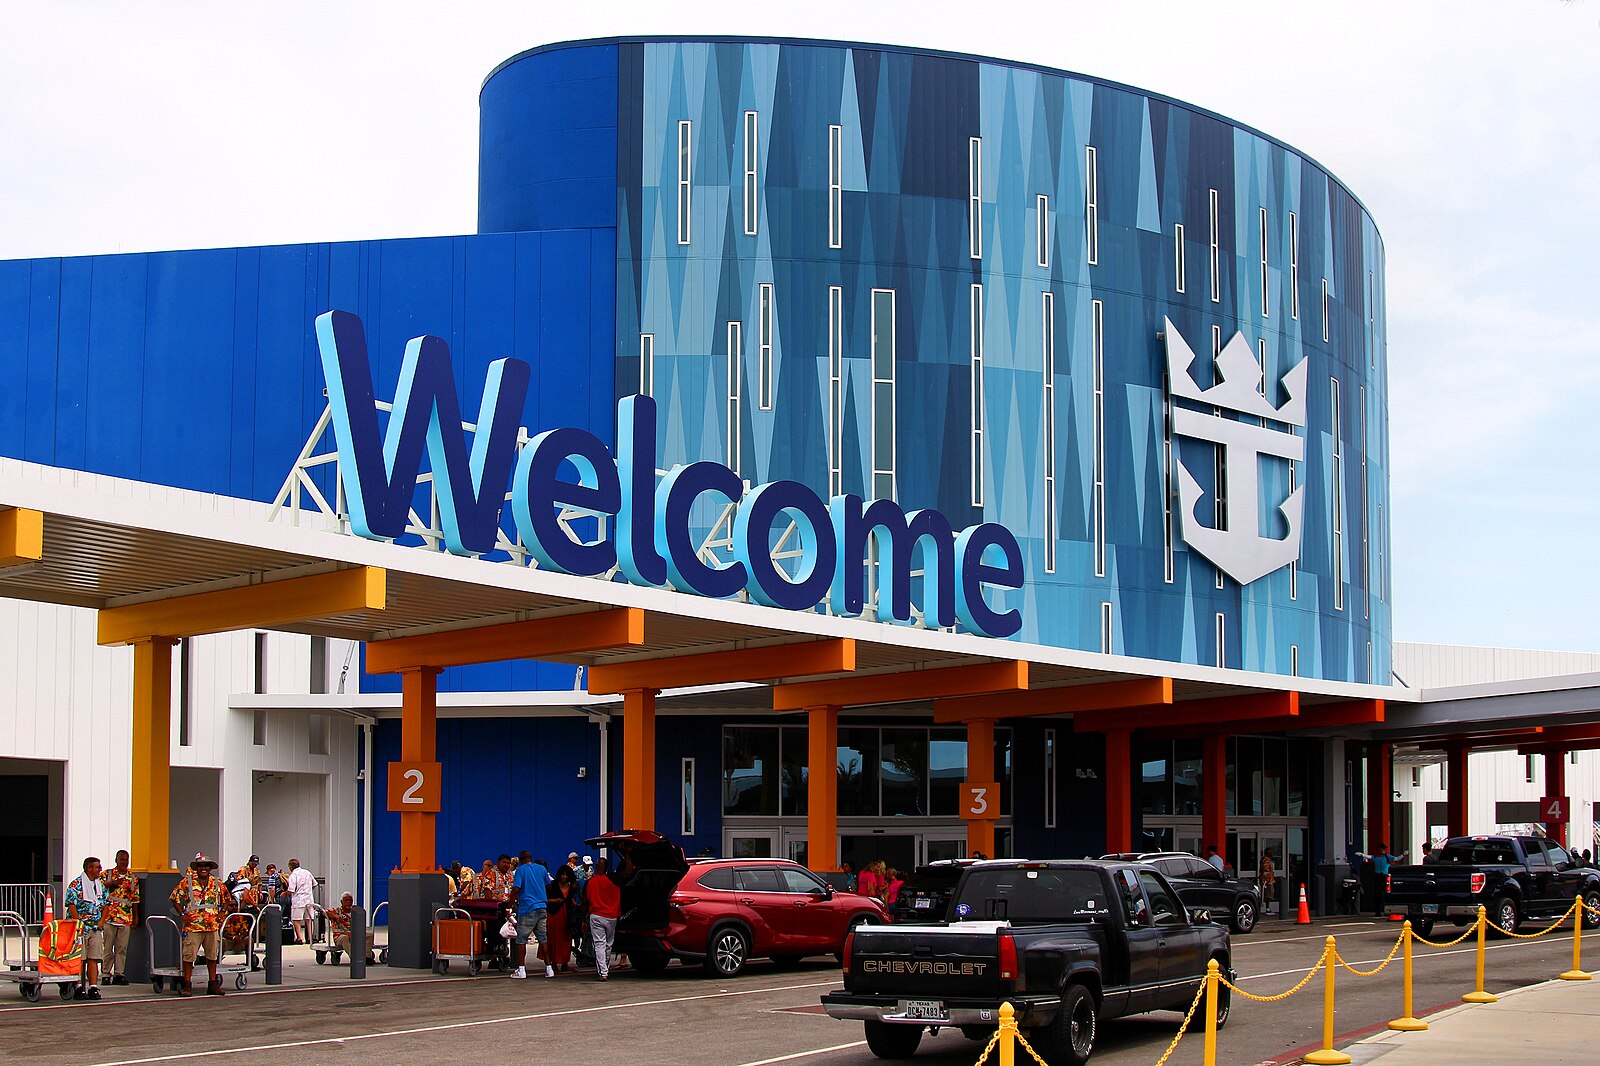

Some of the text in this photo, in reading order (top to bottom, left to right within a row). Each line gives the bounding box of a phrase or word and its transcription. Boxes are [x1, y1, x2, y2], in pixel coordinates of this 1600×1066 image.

[315, 309, 1025, 638] Welcome
[402, 769, 424, 804] 2
[970, 788, 988, 814] 3
[1547, 800, 1562, 819] 4
[863, 960, 987, 975] CHEVROLET
